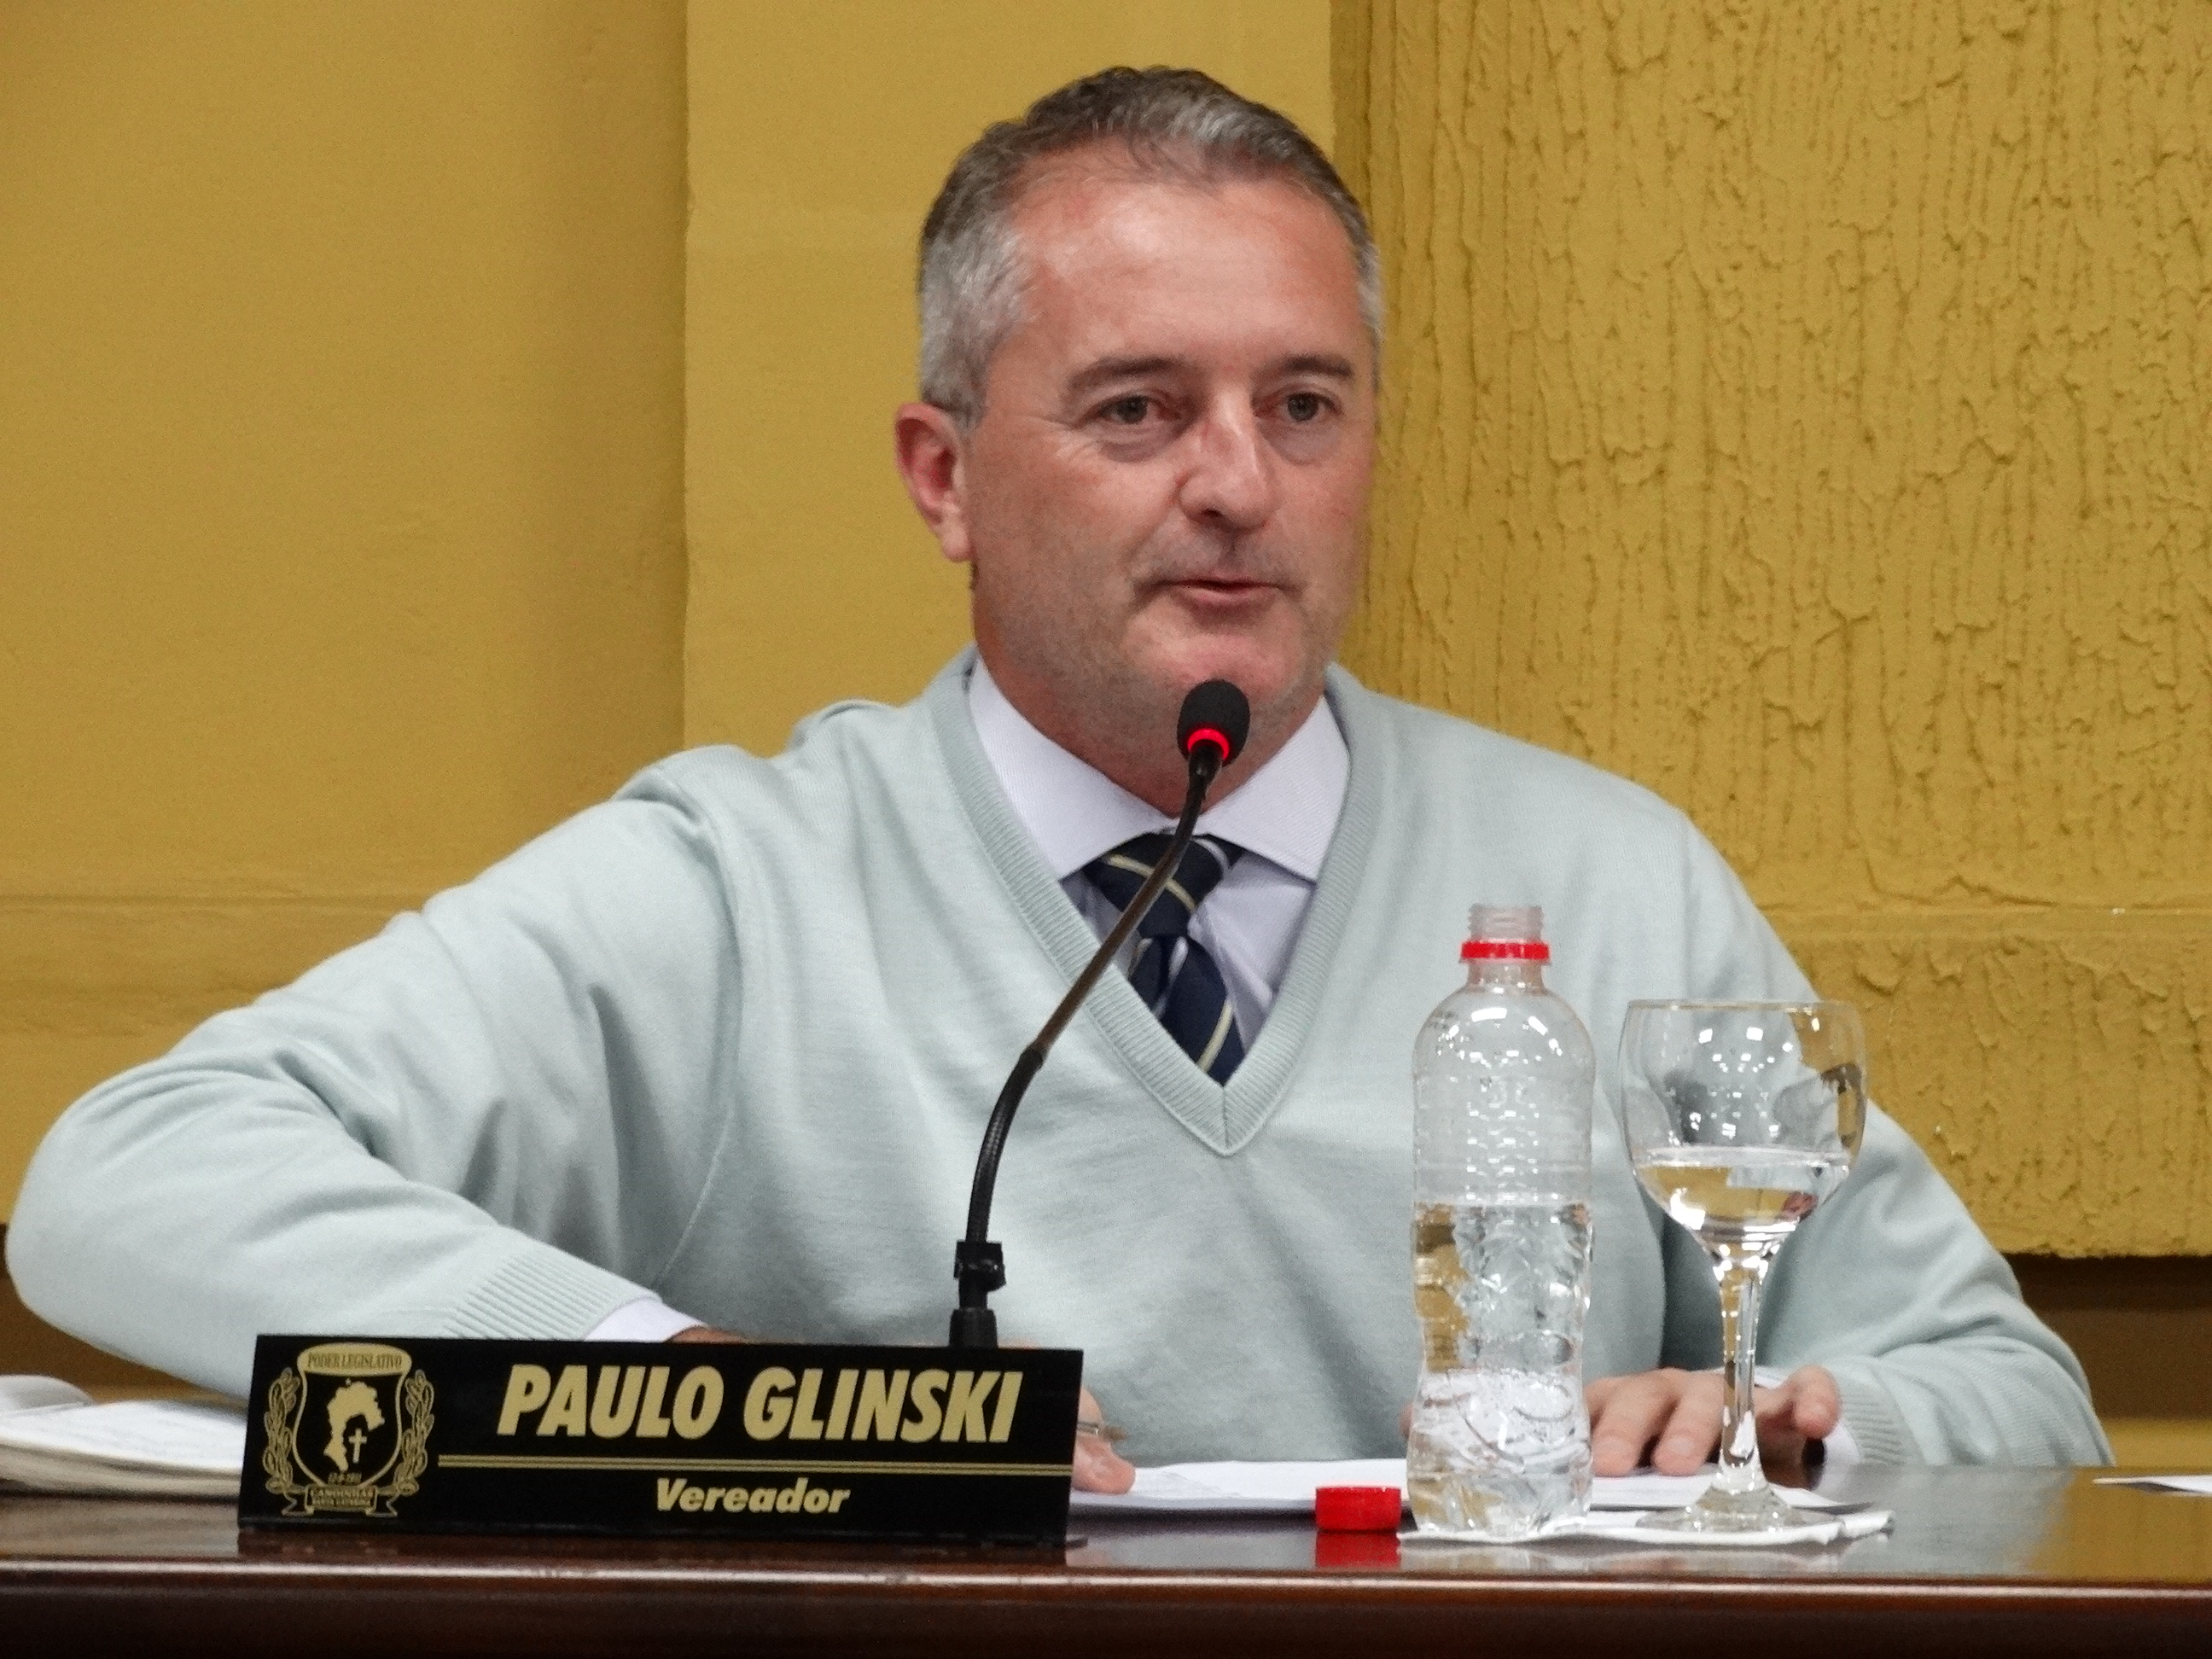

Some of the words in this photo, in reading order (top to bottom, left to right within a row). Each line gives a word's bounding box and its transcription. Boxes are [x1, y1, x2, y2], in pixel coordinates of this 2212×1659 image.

[308, 1353, 341, 1368] PODER
[342, 1353, 402, 1370] LEGISLATIVO
[497, 1364, 724, 1440] PAULO
[743, 1367, 1023, 1443] GLINSKI
[656, 1477, 851, 1514] Vereador
